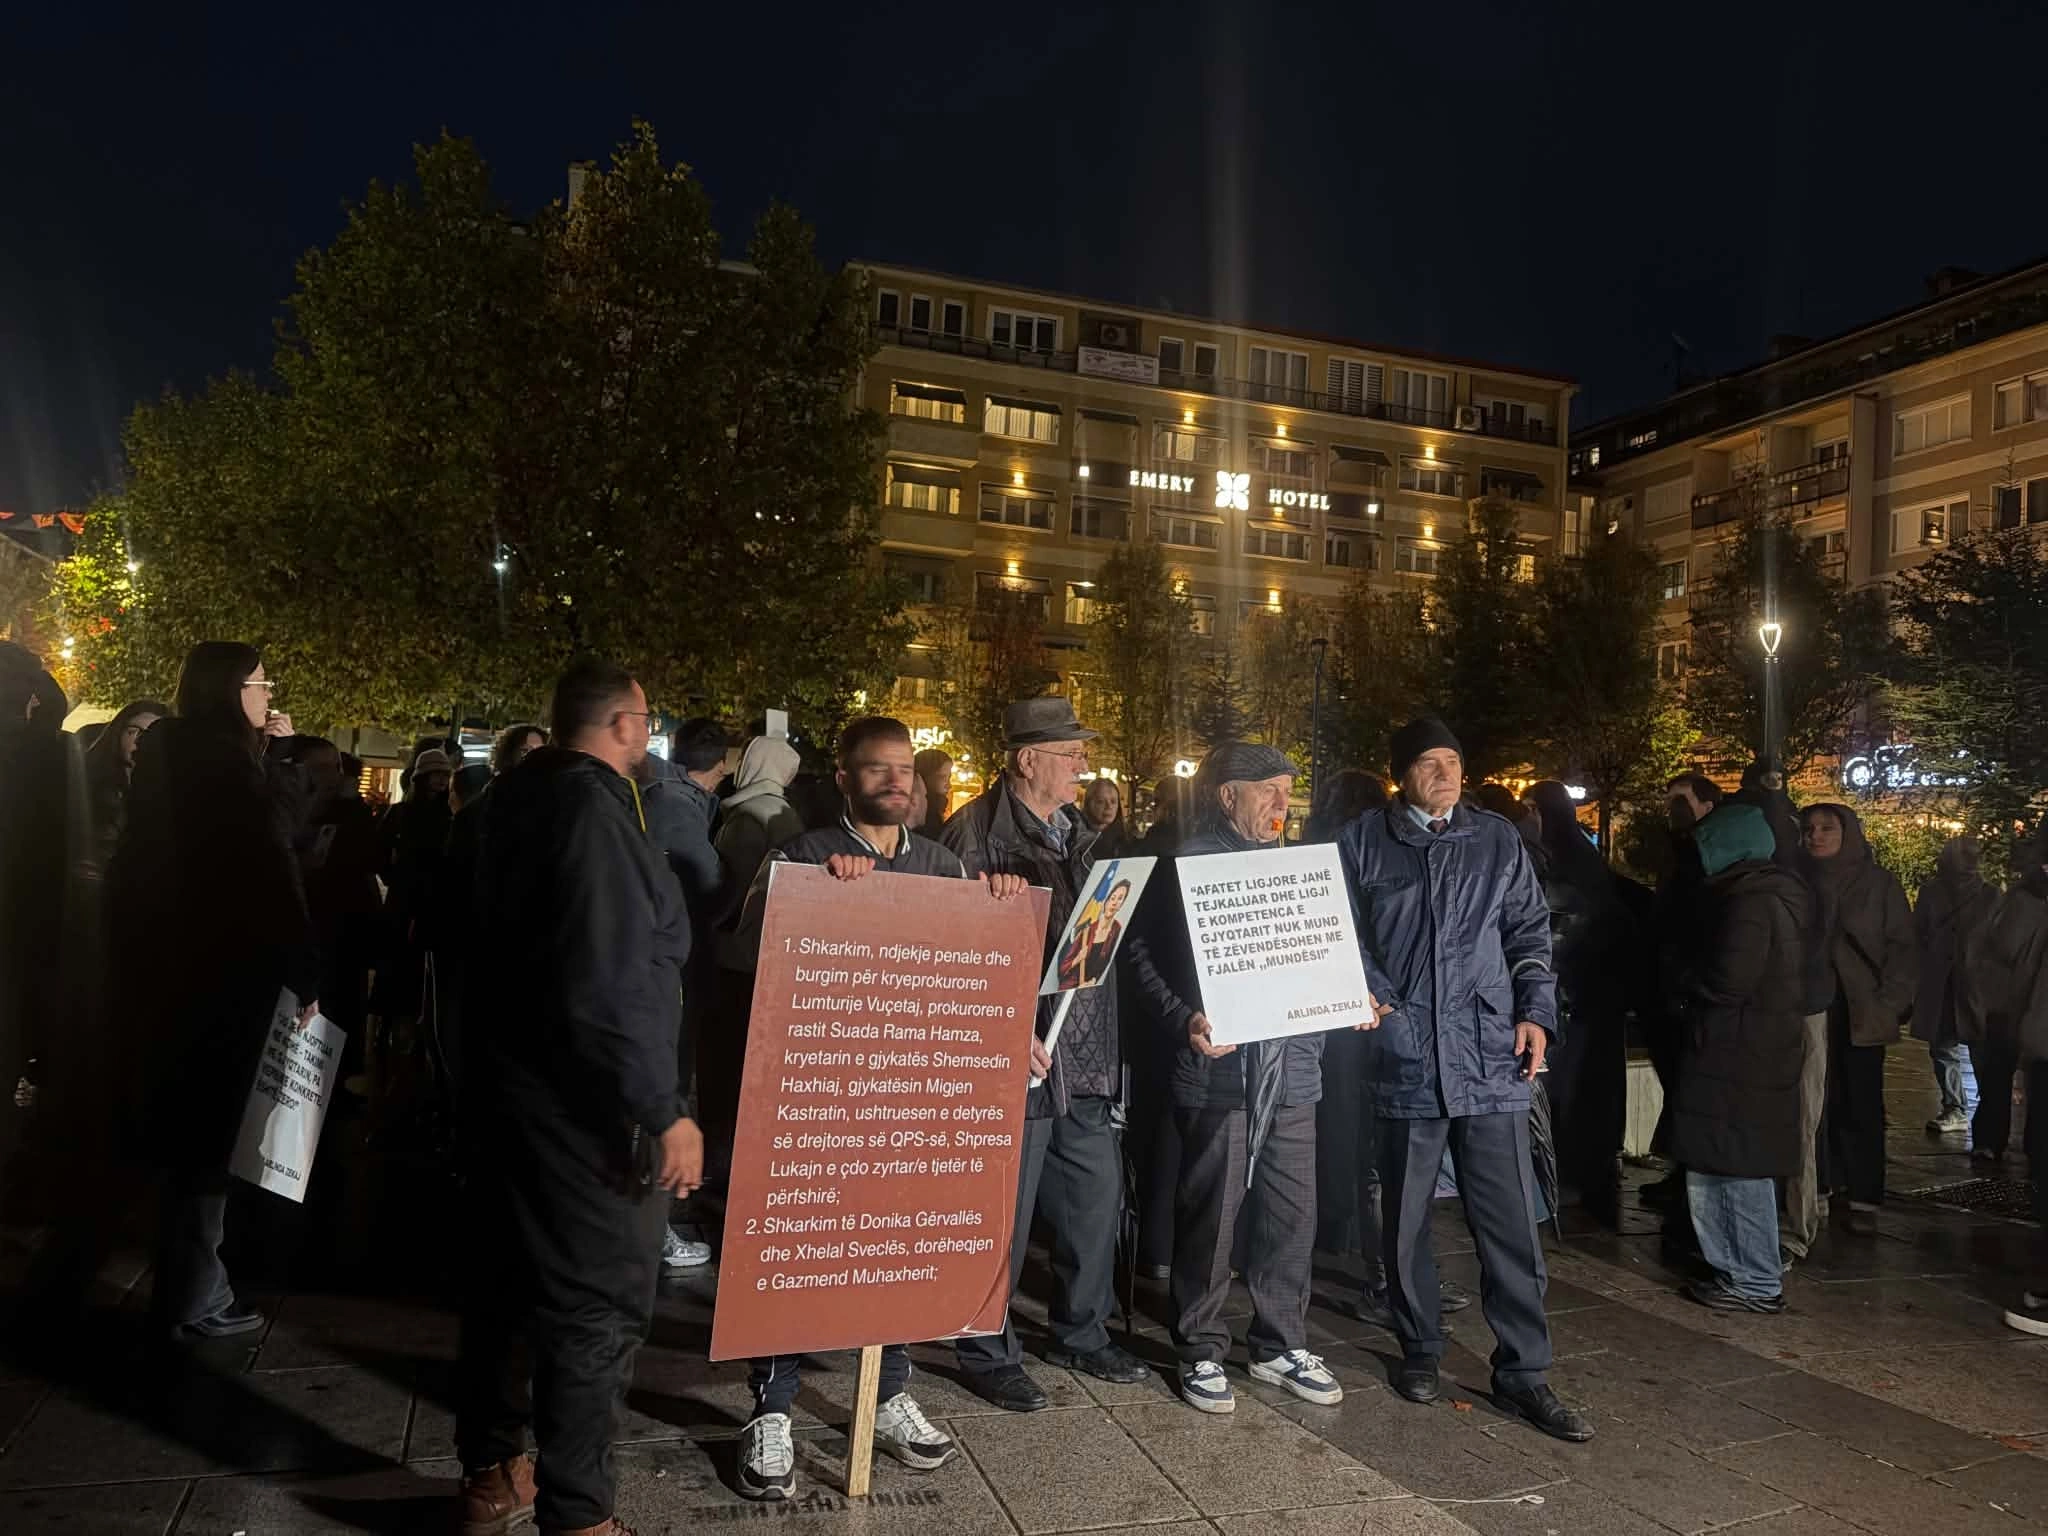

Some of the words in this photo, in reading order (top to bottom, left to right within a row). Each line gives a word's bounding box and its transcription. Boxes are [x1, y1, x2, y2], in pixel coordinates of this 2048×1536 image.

[1130, 470, 1195, 493] EMERY
[1269, 488, 1330, 510] HOTEL
[1246, 874, 1297, 890] LIGJORE
[1300, 868, 1332, 883] JANË
[1194, 894, 1268, 912] TEJKALUAR
[1271, 890, 1296, 903] DHE
[1299, 886, 1329, 898] LIGJI
[1198, 918, 1207, 928] E
[1210, 907, 1293, 927] KOMPETENCA
[1297, 905, 1305, 914] E
[1201, 925, 1271, 944] GJYQTARIT
[1274, 921, 1301, 934] NUK
[1304, 916, 1339, 929] MUND
[785, 938, 796, 952] 1.
[799, 938, 873, 960] Shkarkim,
[879, 944, 930, 964] ndjekje
[934, 949, 981, 966] penale
[985, 951, 1011, 966] dhe
[1204, 948, 1221, 960] TË
[1224, 933, 1322, 957] ZËVENDËSOHEN
[1326, 931, 1343, 943] ME
[796, 965, 848, 986] burgim
[852, 969, 878, 988] për
[881, 970, 987, 990] kryeprokuroren
[1207, 958, 1255, 976] FJALËN
[792, 993, 863, 1015] Lumturije
[867, 996, 923, 1016] Vuçetaj,
[928, 1000, 1003, 1018] prokuroren
[1007, 1007, 1015, 1018] e
[1288, 1006, 1329, 1020] ARLINDA
[1332, 1000, 1363, 1013] ZEKAJ
[788, 1022, 826, 1038] rastit
[830, 1022, 879, 1038] Suada
[884, 1024, 926, 1040] Rama
[930, 1025, 982, 1044] Hamza,
[785, 1049, 851, 1068] kryetarin
[855, 1054, 864, 1065] e
[868, 1051, 928, 1070] gjykatës
[933, 1051, 1010, 1068] Shemsedin
[781, 1076, 842, 1096] Haxhiaj,
[848, 1077, 921, 1096] gjykatësin
[926, 1078, 972, 1097] Migjen
[777, 1104, 849, 1123] Kastratin,
[856, 1105, 936, 1120] ushtruesen
[940, 1108, 949, 1120] e
[953, 1105, 1003, 1123] detyrës
[773, 1133, 792, 1149] së
[797, 1132, 864, 1152] drejtores
[868, 1132, 886, 1147] së
[891, 1131, 949, 1150] QPS-së,
[955, 1131, 1012, 1150] Shpresa
[771, 1160, 822, 1180] Lukajn
[827, 1164, 836, 1175] e
[840, 1160, 869, 1179] çdo
[872, 1158, 927, 1178] zyrtar/e
[932, 1158, 967, 1176] tjetër
[971, 1157, 983, 1172] të
[767, 1187, 840, 1209] përfshirë;
[745, 1219, 760, 1234] 2.
[764, 1216, 837, 1233] Shkarkim
[842, 1214, 856, 1230] të
[860, 1213, 912, 1229] Donika
[916, 1210, 982, 1227] Gërvallës
[760, 1246, 791, 1262] dhe
[795, 1242, 844, 1260] Xhelal
[914, 1236, 993, 1254] dorëheqjen
[757, 1278, 767, 1290] e
[772, 1270, 848, 1289] Gazmend
[853, 1264, 938, 1284] Muhaxherit;
